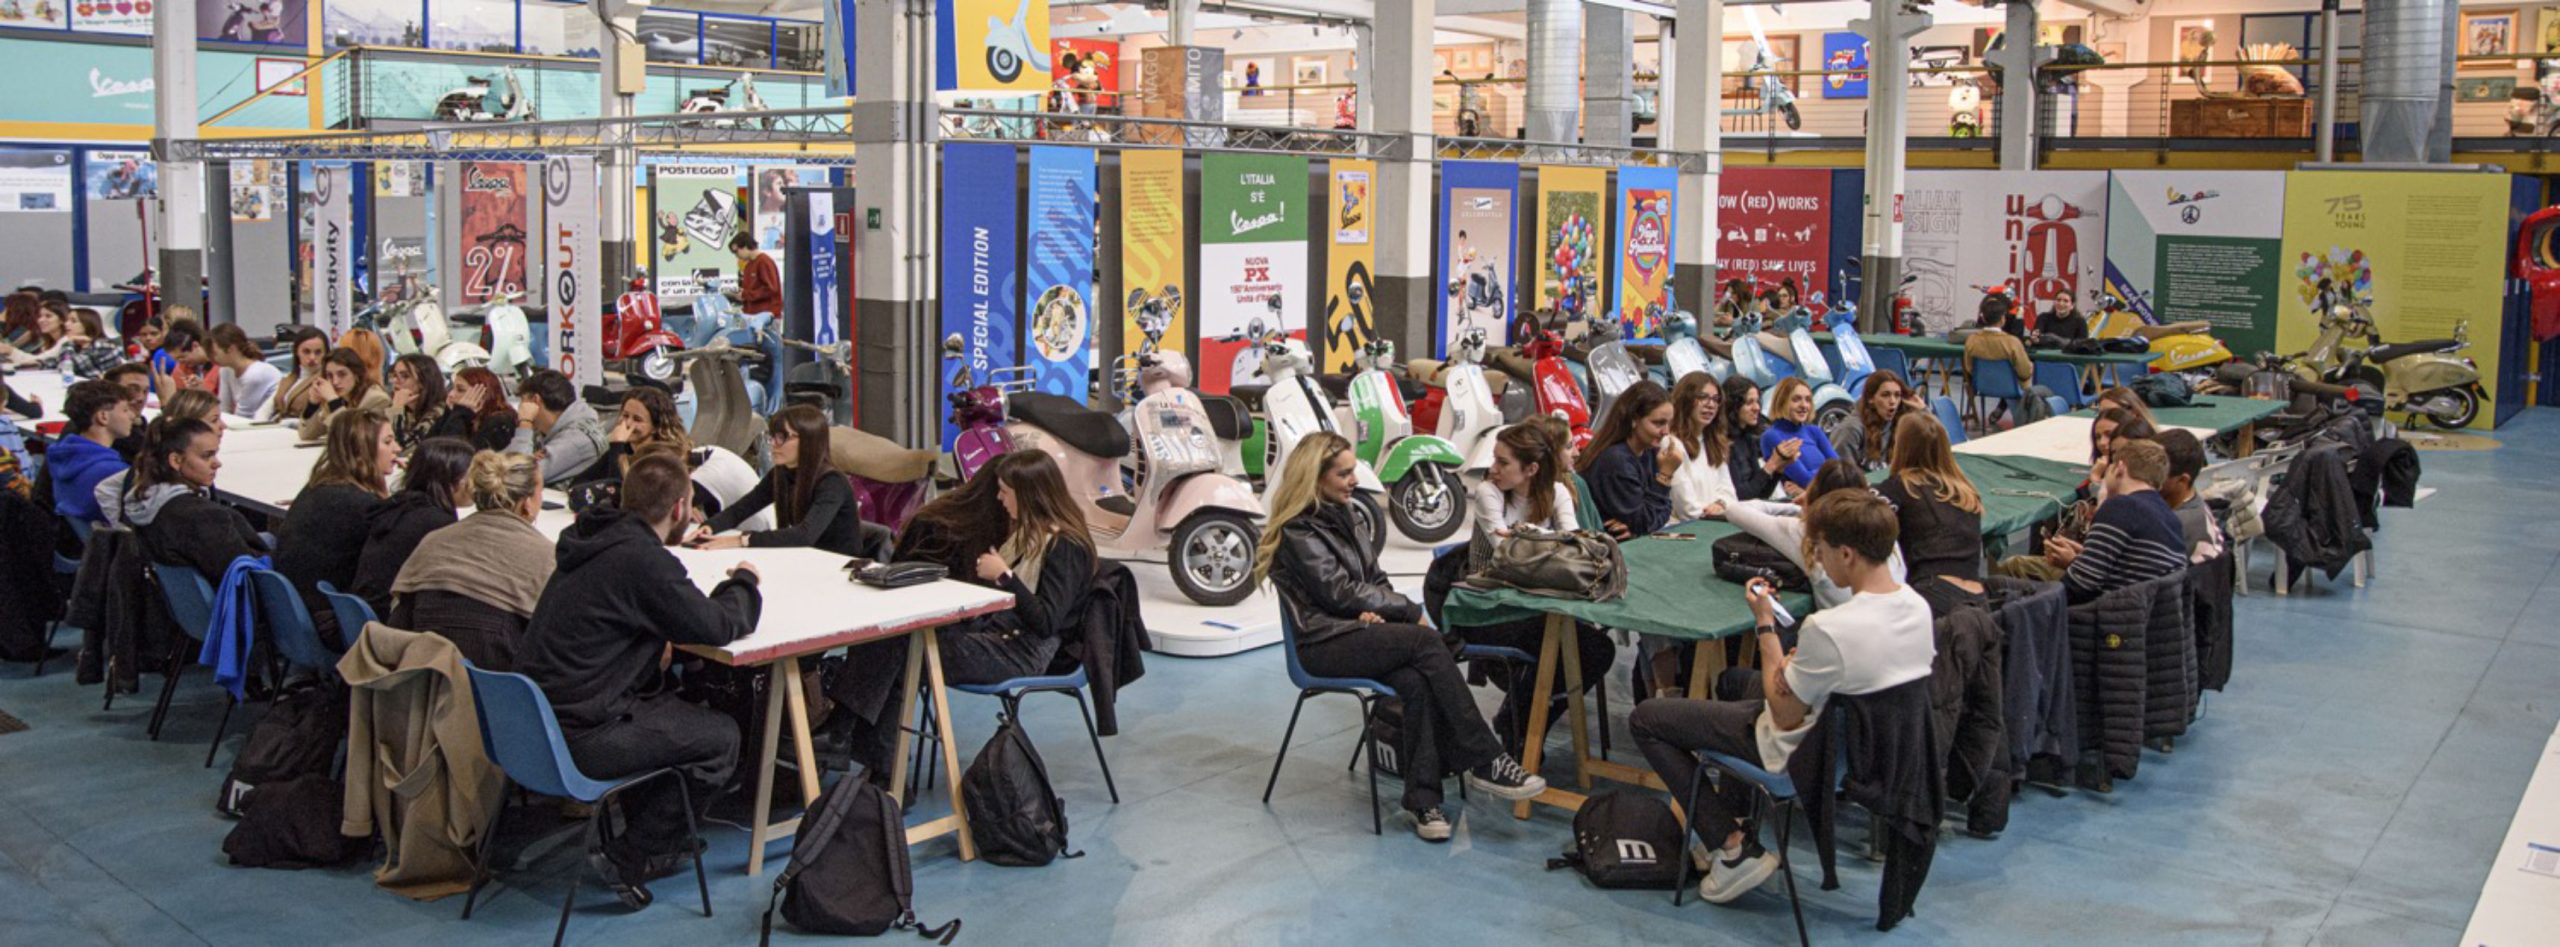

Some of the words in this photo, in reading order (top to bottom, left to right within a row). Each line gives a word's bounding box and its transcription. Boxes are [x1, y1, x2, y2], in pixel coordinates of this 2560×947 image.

[659, 165, 729, 175] POSTEGGIO
[1240, 173, 1276, 186] L'ITALIA
[1718, 196, 1738, 209] OW
[1740, 190, 1775, 215] (RED)
[1776, 196, 1819, 211] WORKS
[2324, 194, 2363, 215] 75
[2335, 213, 2366, 221] YEARS
[2335, 221, 2366, 229] YOUNG
[381, 237, 424, 260] Vespa
[973, 226, 990, 296] EDITION
[1245, 257, 1269, 265] NUOVA
[1732, 259, 1760, 271] (RED)
[1788, 260, 1817, 273] LIVES
[466, 246, 517, 297] 2%
[1244, 267, 1270, 282] PX
[973, 299, 989, 372] SPECIAL
[1616, 839, 1657, 859] m
